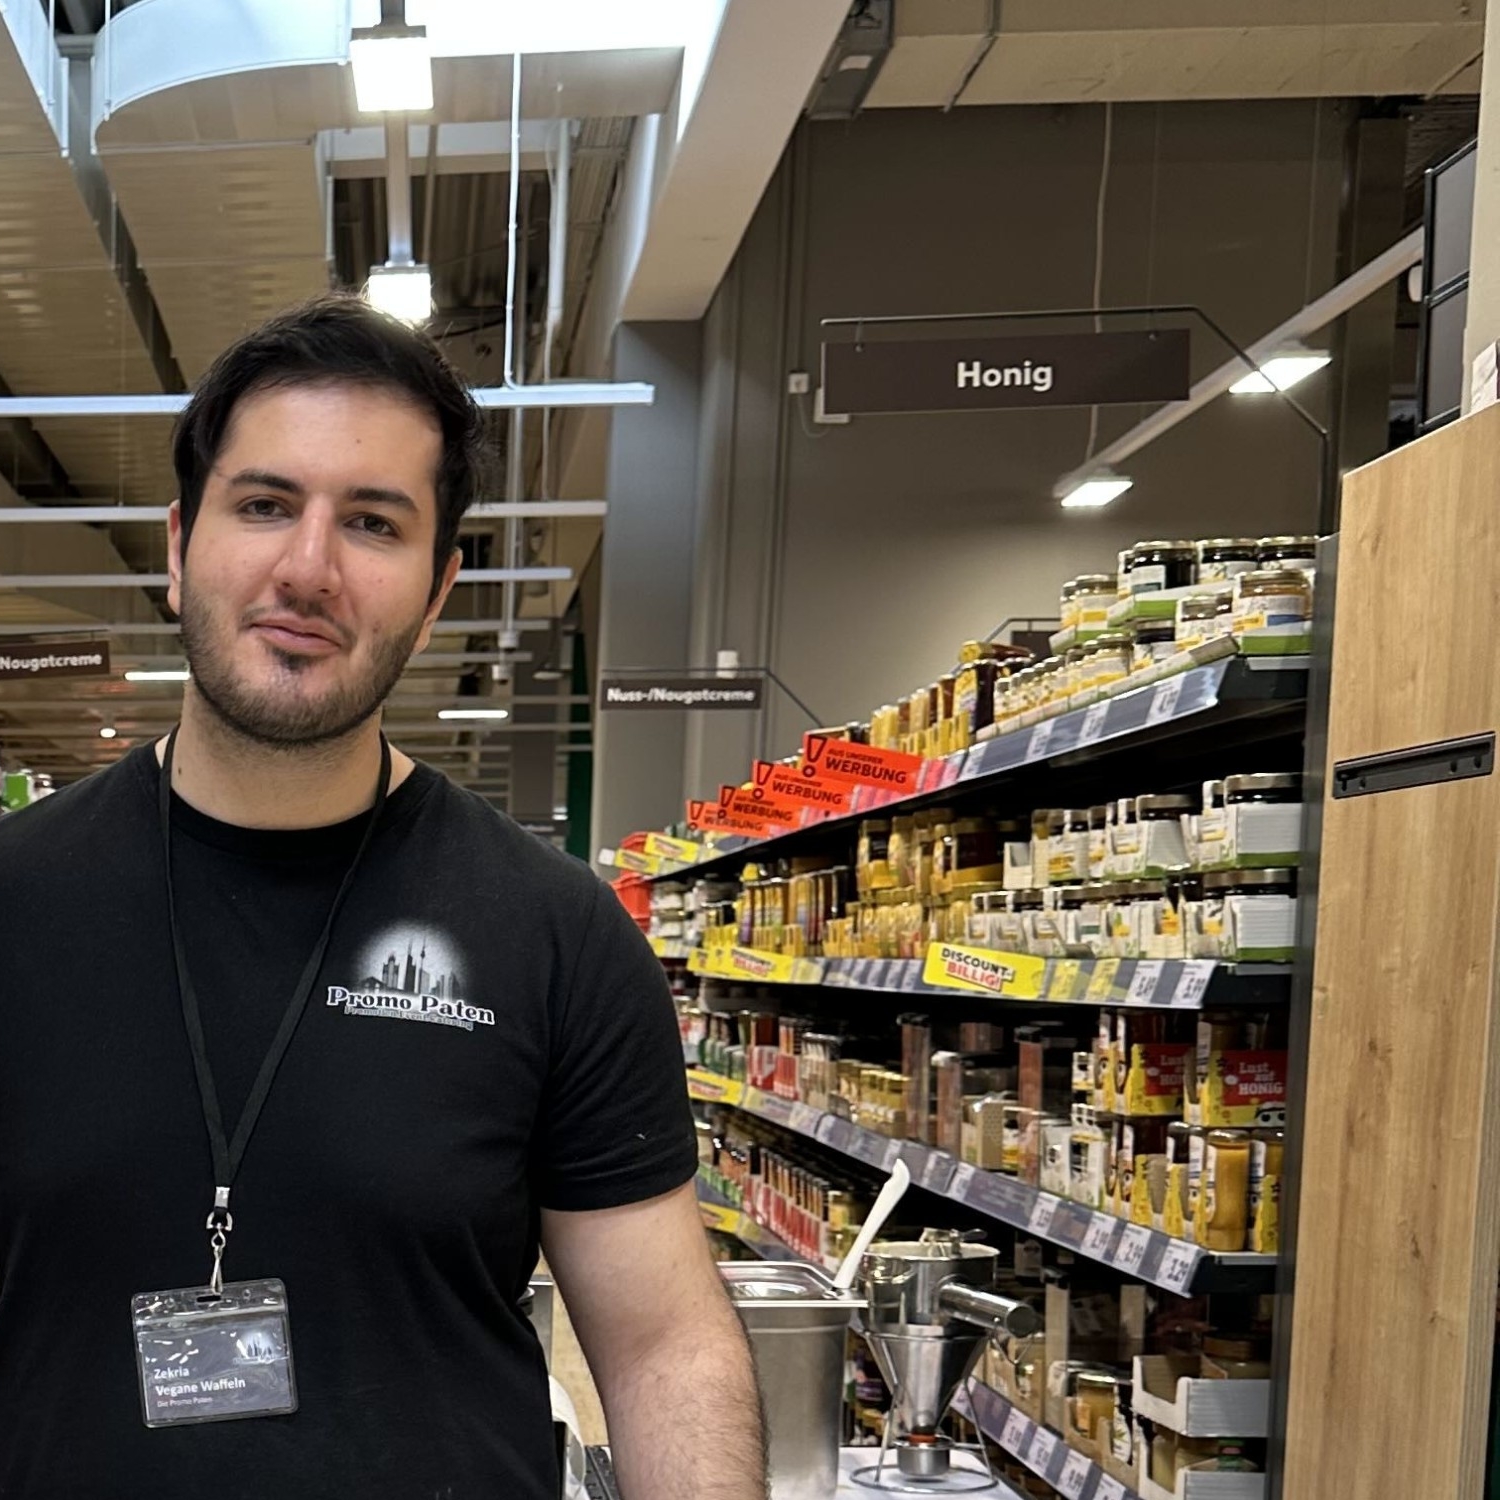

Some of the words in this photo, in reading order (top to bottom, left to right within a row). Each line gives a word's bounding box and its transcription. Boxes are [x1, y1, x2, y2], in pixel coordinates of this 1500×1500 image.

[957, 361, 1054, 392] Honig
[607, 687, 755, 705] Nuss-/Nougatcreme
[825, 756, 907, 785] WERBUNG
[772, 780, 843, 805] WERBUNG
[732, 800, 793, 822] WERBUNG
[941, 947, 1012, 979] DISCOUNT-
[946, 960, 1001, 992] BILLIG!
[327, 986, 412, 1011] Promo
[419, 995, 496, 1025] Paten
[1239, 1062, 1269, 1074] Lust
[1238, 1082, 1283, 1096] HONIG
[154, 1366, 190, 1380] Zekria
[155, 1384, 199, 1398] Vegane
[200, 1377, 246, 1392] Waffeln
